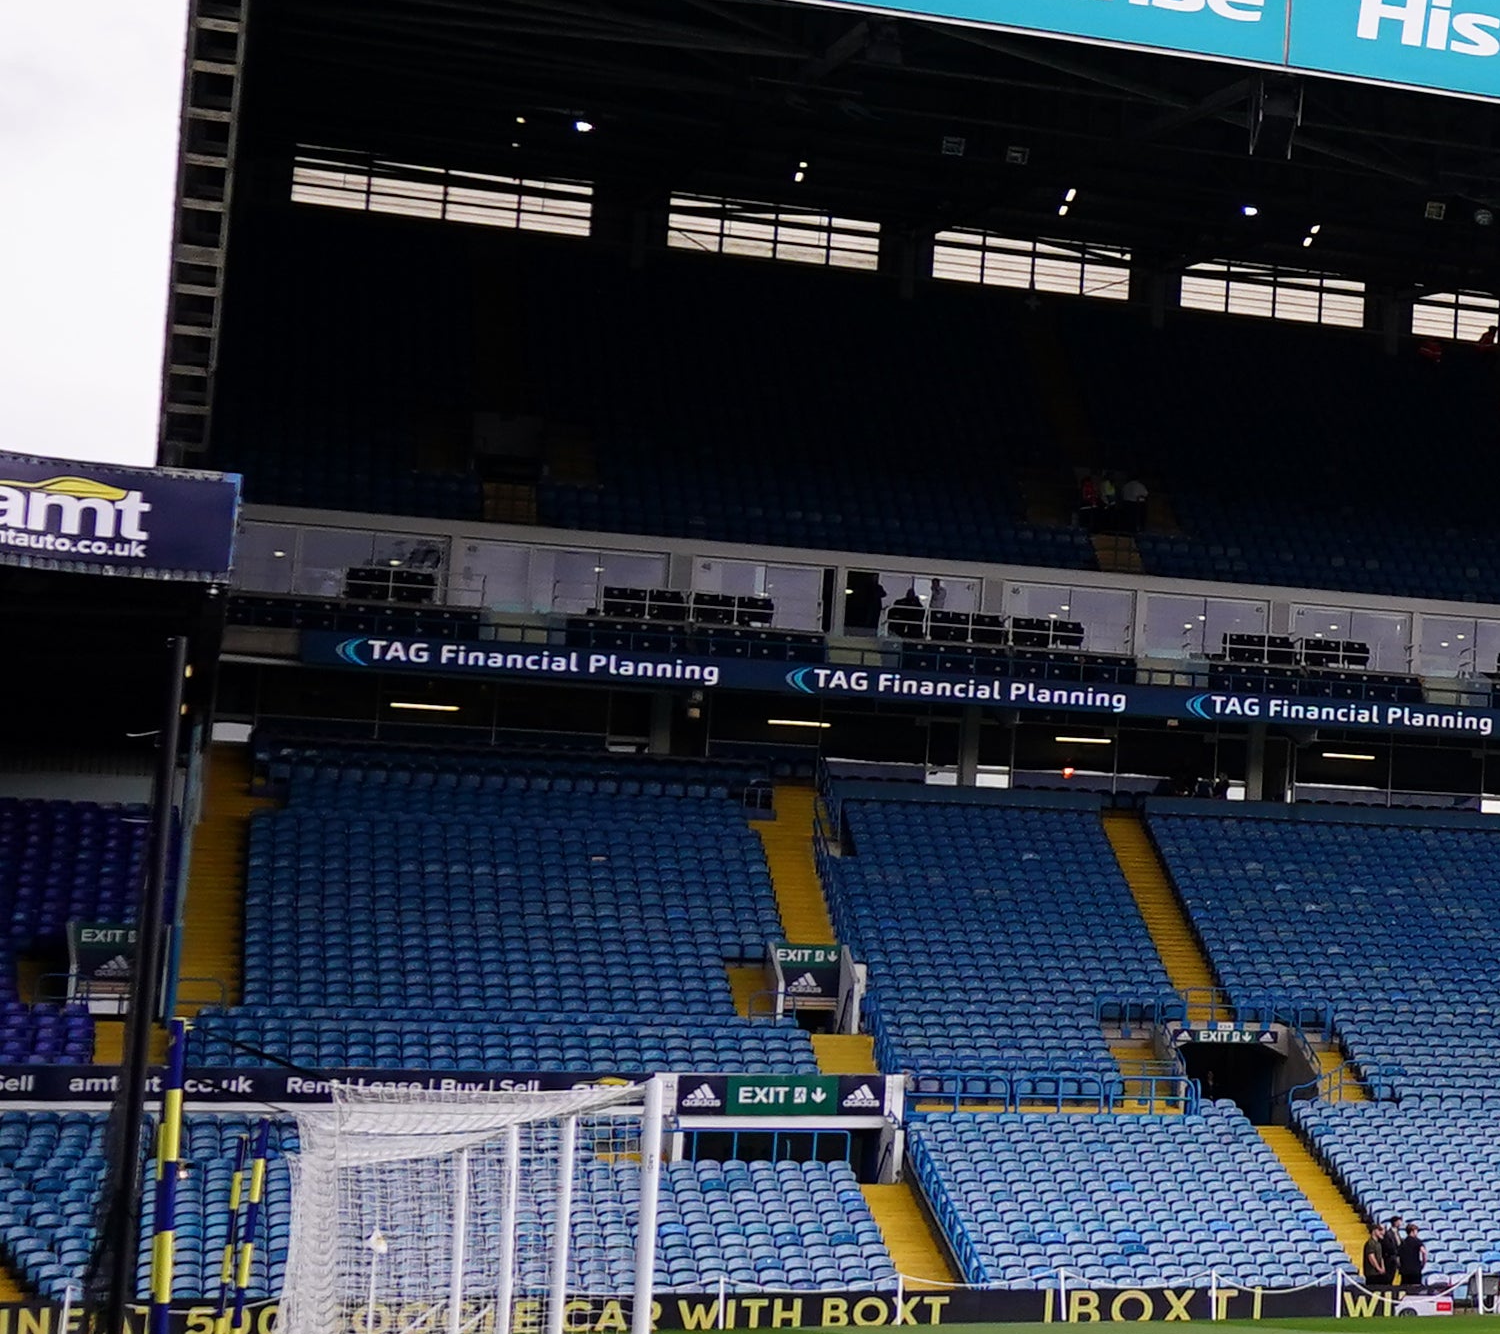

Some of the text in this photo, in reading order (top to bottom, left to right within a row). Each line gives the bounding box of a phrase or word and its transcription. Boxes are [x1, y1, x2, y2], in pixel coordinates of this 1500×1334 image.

[0, 486, 152, 541] amt
[368, 640, 718, 685] TAG Financial Planning
[814, 669, 1126, 712] TAG Financial Planning
[1211, 696, 1492, 735] TAG Financial Planning
[81, 928, 123, 943] EXIT
[777, 950, 813, 962] EXIT
[1199, 1030, 1230, 1042] EXIT
[682, 1099, 722, 1108] adidas
[739, 1087, 789, 1103] EXIT
[842, 1099, 880, 1108] adidas
[679, 1298, 800, 1329] WITH
[822, 1295, 949, 1327] BOXT
[1068, 1288, 1240, 1322] BOXT
[1344, 1290, 1406, 1317] WI
